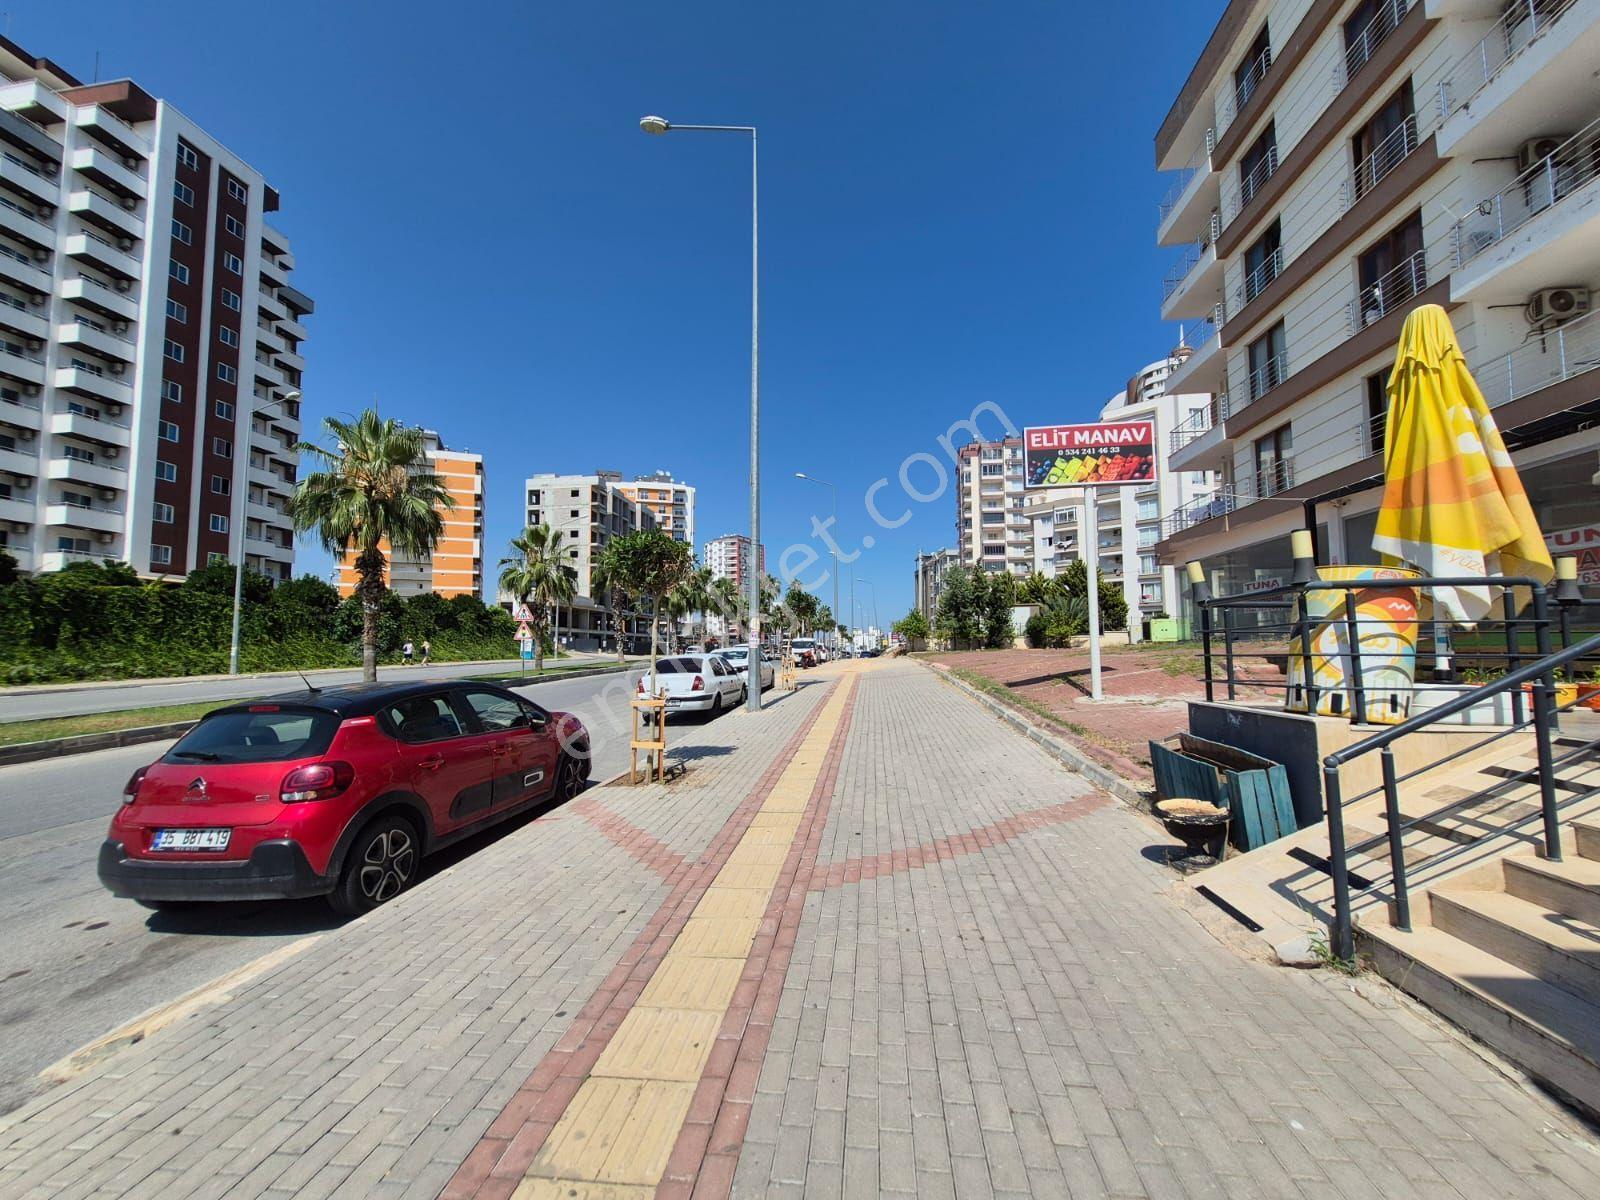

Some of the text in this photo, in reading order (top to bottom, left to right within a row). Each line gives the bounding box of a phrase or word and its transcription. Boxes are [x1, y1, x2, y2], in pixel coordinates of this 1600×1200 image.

[1031, 427, 1146, 447] ELİT MANAV
[1065, 448, 1080, 456] 534
[1081, 447, 1096, 455] 241
[1110, 446, 1120, 454] 33
[1246, 580, 1280, 590] TUNA
[162, 831, 176, 844] 35
[207, 831, 229, 844] 419
